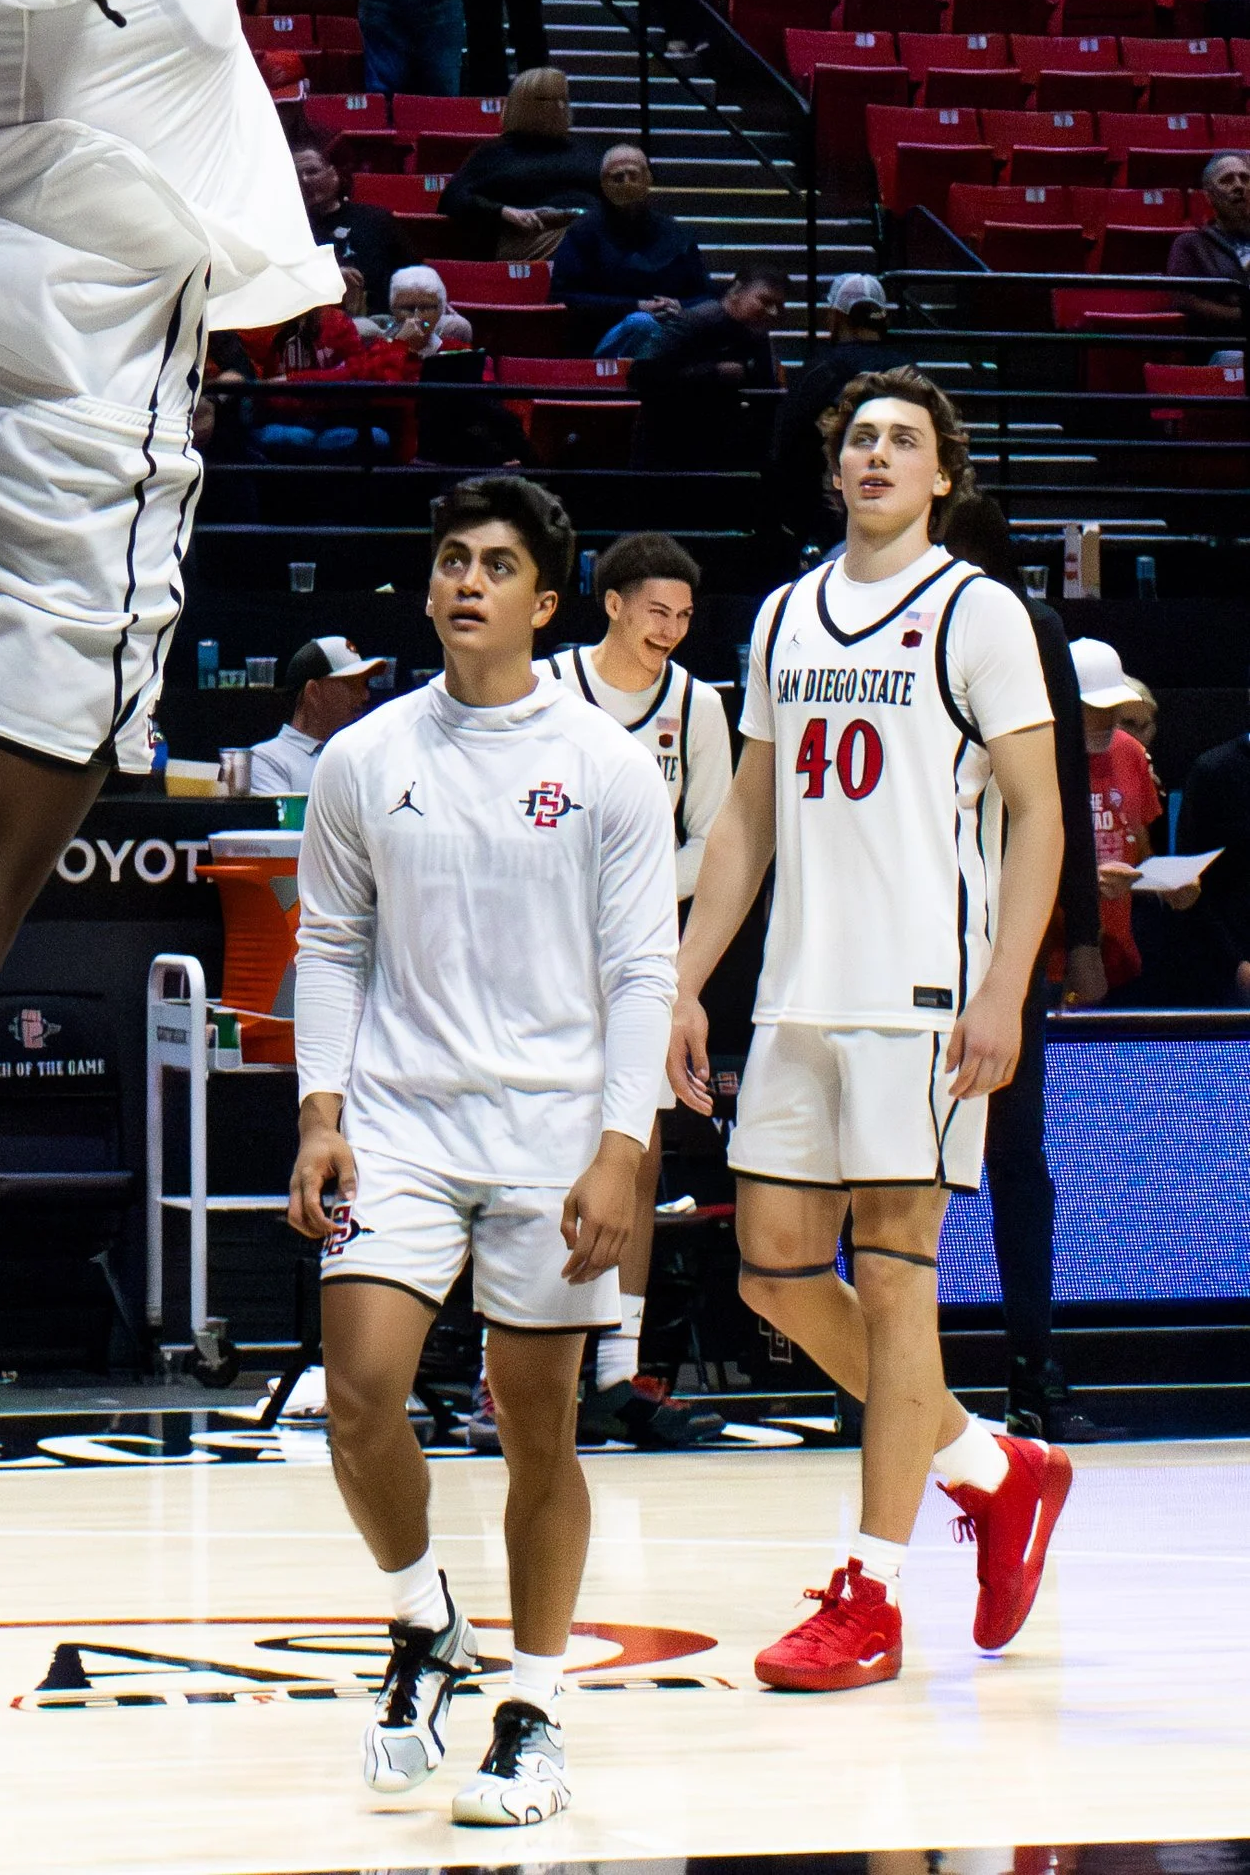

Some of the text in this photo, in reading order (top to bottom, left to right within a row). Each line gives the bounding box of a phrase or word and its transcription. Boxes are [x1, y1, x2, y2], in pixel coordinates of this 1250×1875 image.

[777, 668, 916, 707] SAN DIEGO STATE
[796, 717, 884, 801] 40
[56, 838, 214, 884] OYOT
[15, 1061, 34, 1077] OF
[36, 1060, 64, 1076] THE
